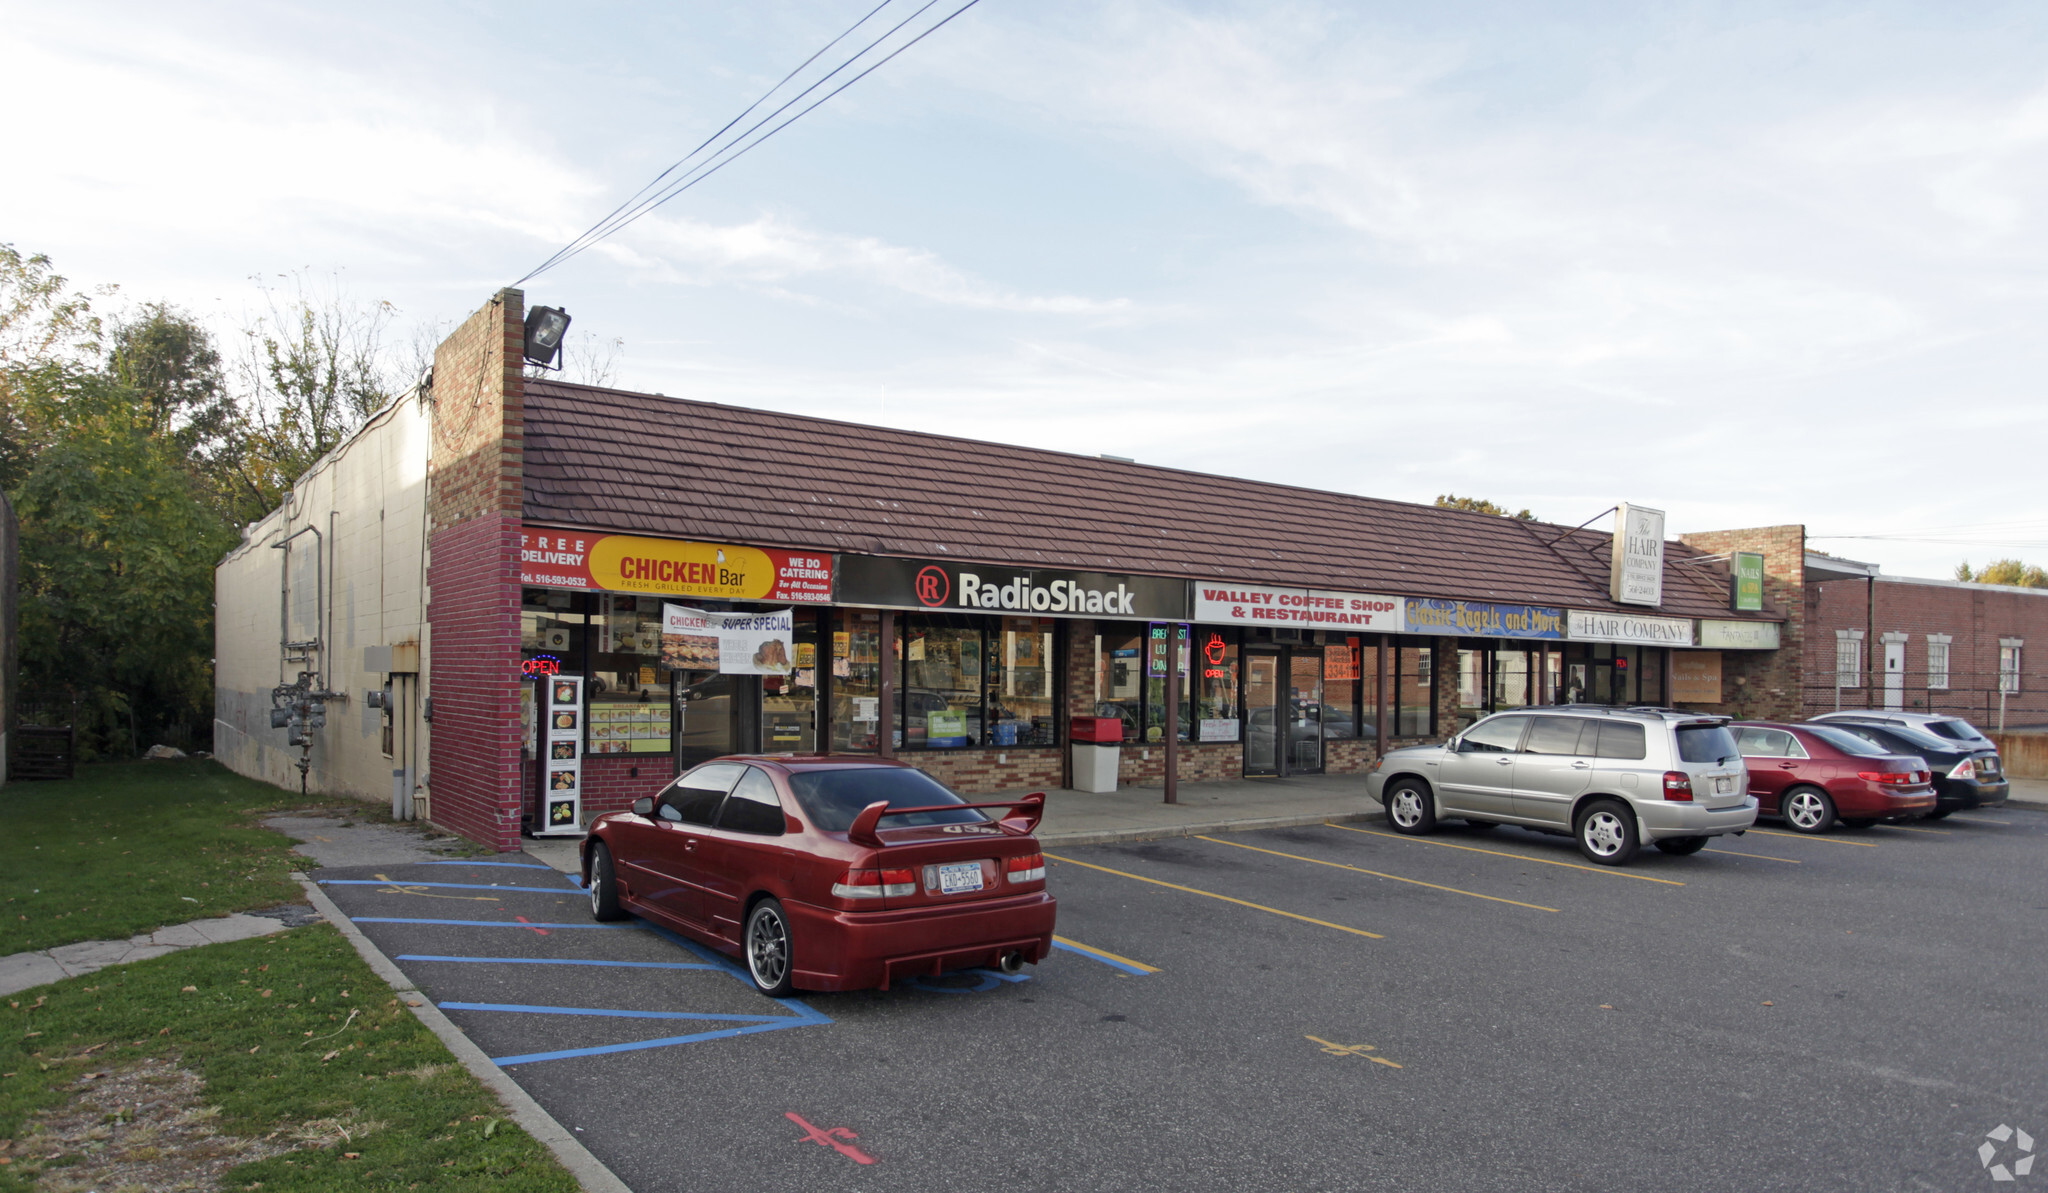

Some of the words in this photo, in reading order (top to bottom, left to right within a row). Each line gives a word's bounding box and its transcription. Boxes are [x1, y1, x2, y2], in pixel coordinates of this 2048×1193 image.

[1629, 536, 1657, 557] HAIR
[521, 549, 584, 566] DELIVERY
[789, 557, 804, 568] WE
[806, 558, 820, 568] DO
[1626, 557, 1657, 570] COMPANY
[620, 556, 716, 585] CHICKEN
[719, 568, 746, 586] Bar
[780, 567, 829, 580] CATERING
[1740, 567, 1760, 579] NAILS
[535, 574, 587, 587] 516-593-0532
[621, 580, 649, 588] FRESH
[655, 582, 693, 592] GRILLED
[778, 580, 789, 588] For
[790, 581, 801, 589] All
[776, 591, 789, 600] Fax.
[959, 573, 1135, 614] RadioShack
[1203, 589, 1274, 605] VALLEY
[1278, 594, 1345, 609] COFFEE
[1350, 599, 1395, 612] SHOP
[670, 615, 706, 629] CHICKEN
[1231, 606, 1246, 618] &
[1252, 607, 1372, 625] RESTAURANT
[1406, 601, 1450, 627] Classic
[1456, 605, 1500, 633] Bagels
[1505, 608, 1528, 631] and
[1531, 610, 1561, 632] More
[721, 618, 752, 631] SUPER
[753, 616, 791, 631] SPECIAL
[521, 660, 559, 674] OPEN
[1616, 658, 1628, 668] PEN
[1205, 669, 1224, 678] OPEN
